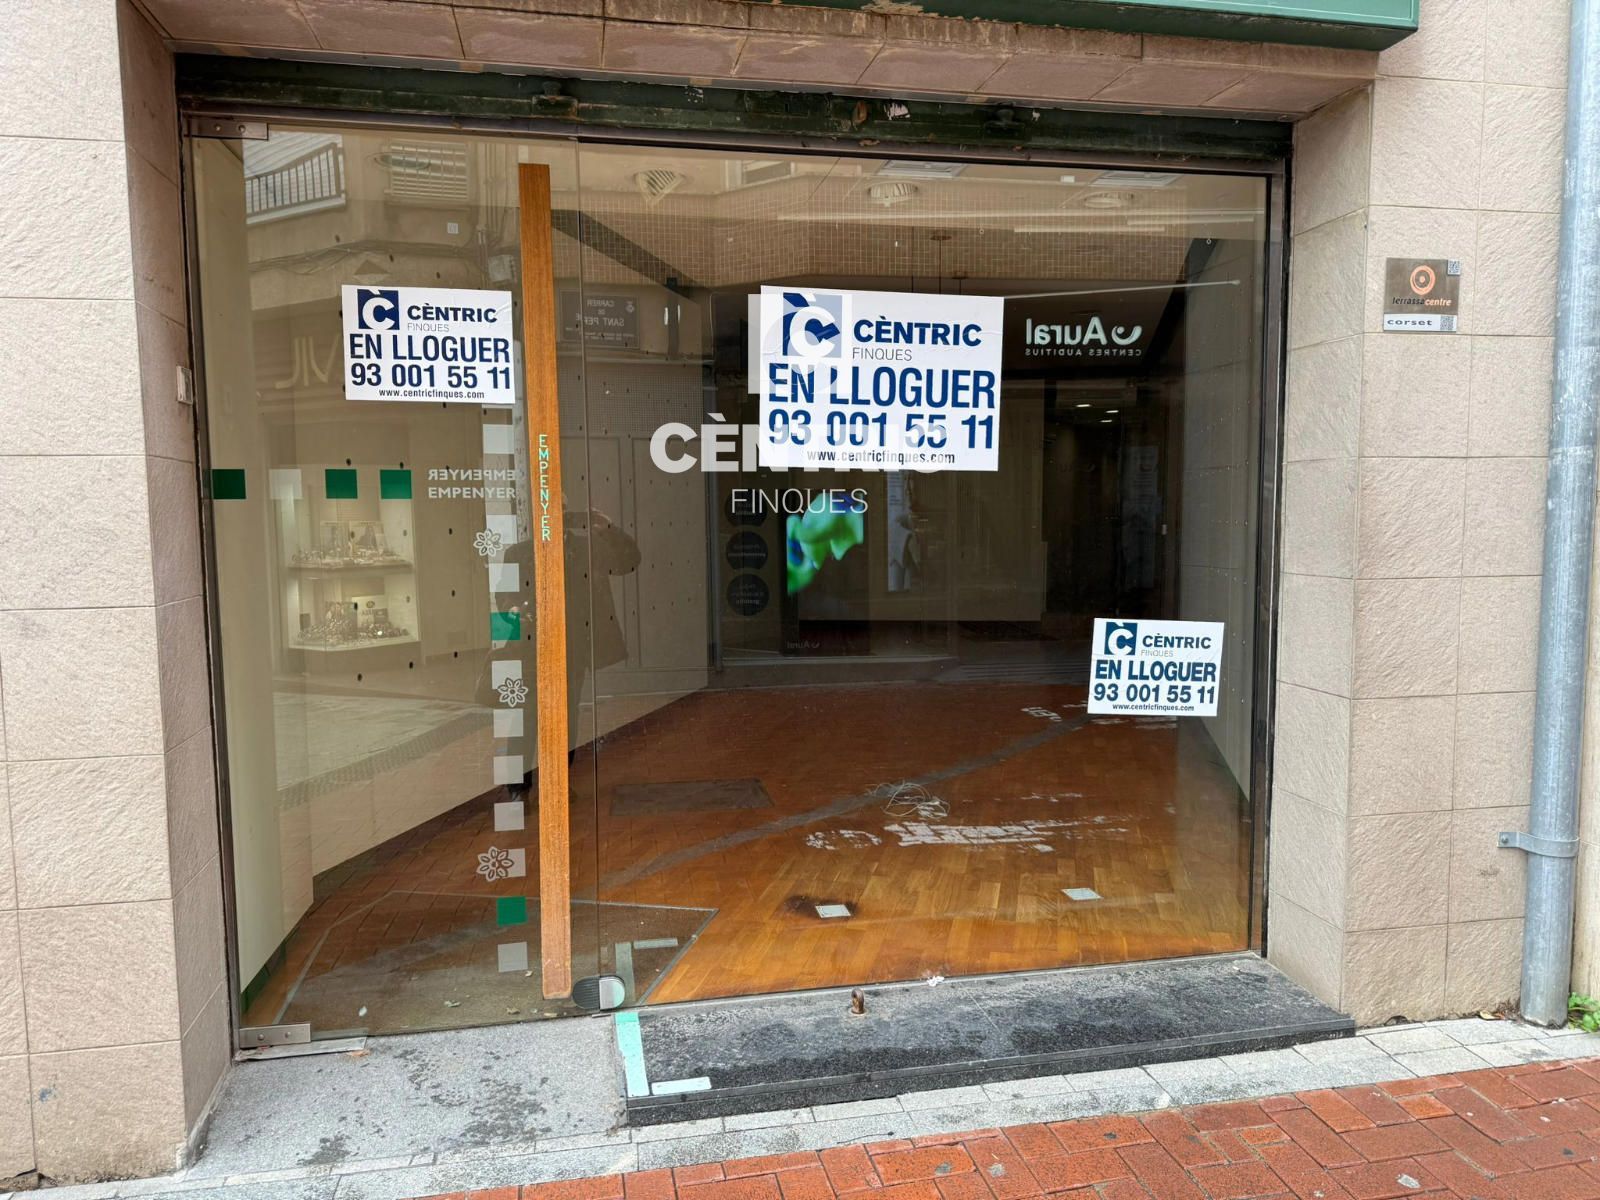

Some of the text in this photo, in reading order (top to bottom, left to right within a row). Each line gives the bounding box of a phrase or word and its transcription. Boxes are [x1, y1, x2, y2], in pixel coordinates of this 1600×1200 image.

[407, 303, 498, 323] CÈNTRIC
[407, 322, 450, 333] FINQUES
[853, 315, 982, 347] CÈNTRIC
[350, 333, 510, 363] EN LLOGUER
[852, 347, 913, 361] FINQUES
[351, 363, 510, 389] 93 001 55 11
[768, 362, 996, 409] EN LLOGUER
[379, 389, 485, 399] www.centricfinques.com
[768, 408, 994, 449] 93 001 55 11
[807, 451, 955, 465] www.centricfinques.com
[428, 487, 516, 499] EMPENYER
[538, 434, 551, 541] EMPENYER
[731, 488, 869, 515] FINQUES
[1142, 633, 1211, 649] CÈNTRIC
[1141, 650, 1174, 658] FINQUES
[1095, 659, 1217, 682] EN LLOGUER
[1094, 683, 1215, 704] 93 001 55 11
[1112, 703, 1195, 712] www.centricfinques.com
